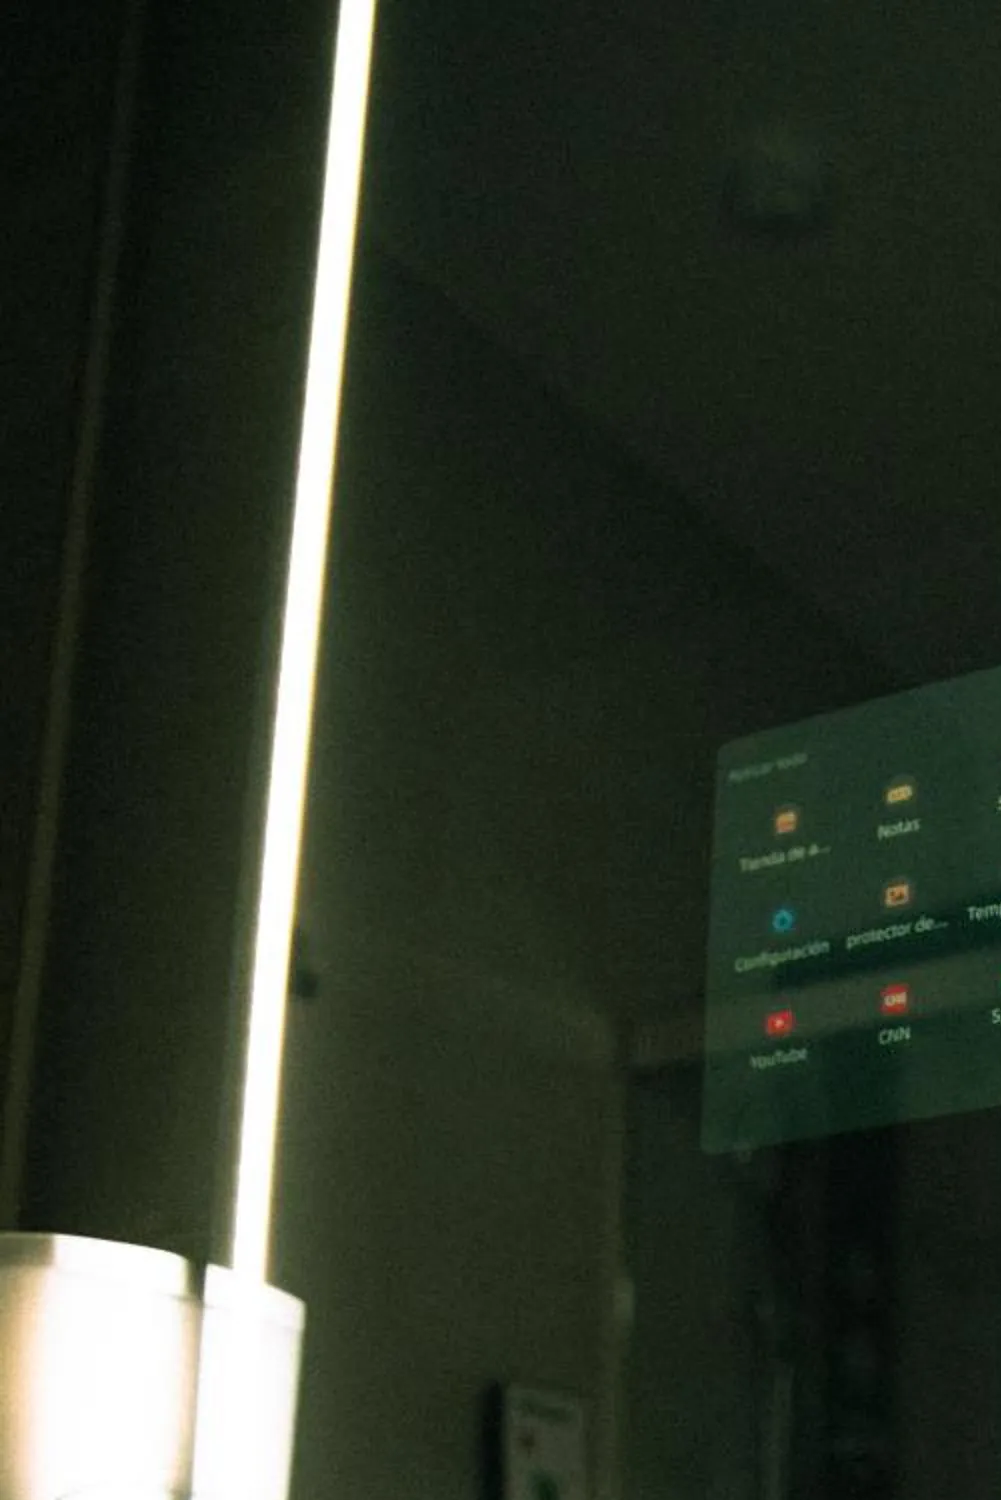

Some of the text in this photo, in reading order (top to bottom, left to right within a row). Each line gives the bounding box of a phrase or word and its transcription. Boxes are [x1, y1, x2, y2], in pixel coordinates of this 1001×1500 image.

[877, 817, 921, 840] Notas
[846, 923, 911, 950] protector
[734, 938, 831, 973] Configuración
[878, 1027, 911, 1045] CNN
[749, 1047, 808, 1069] YouTube
